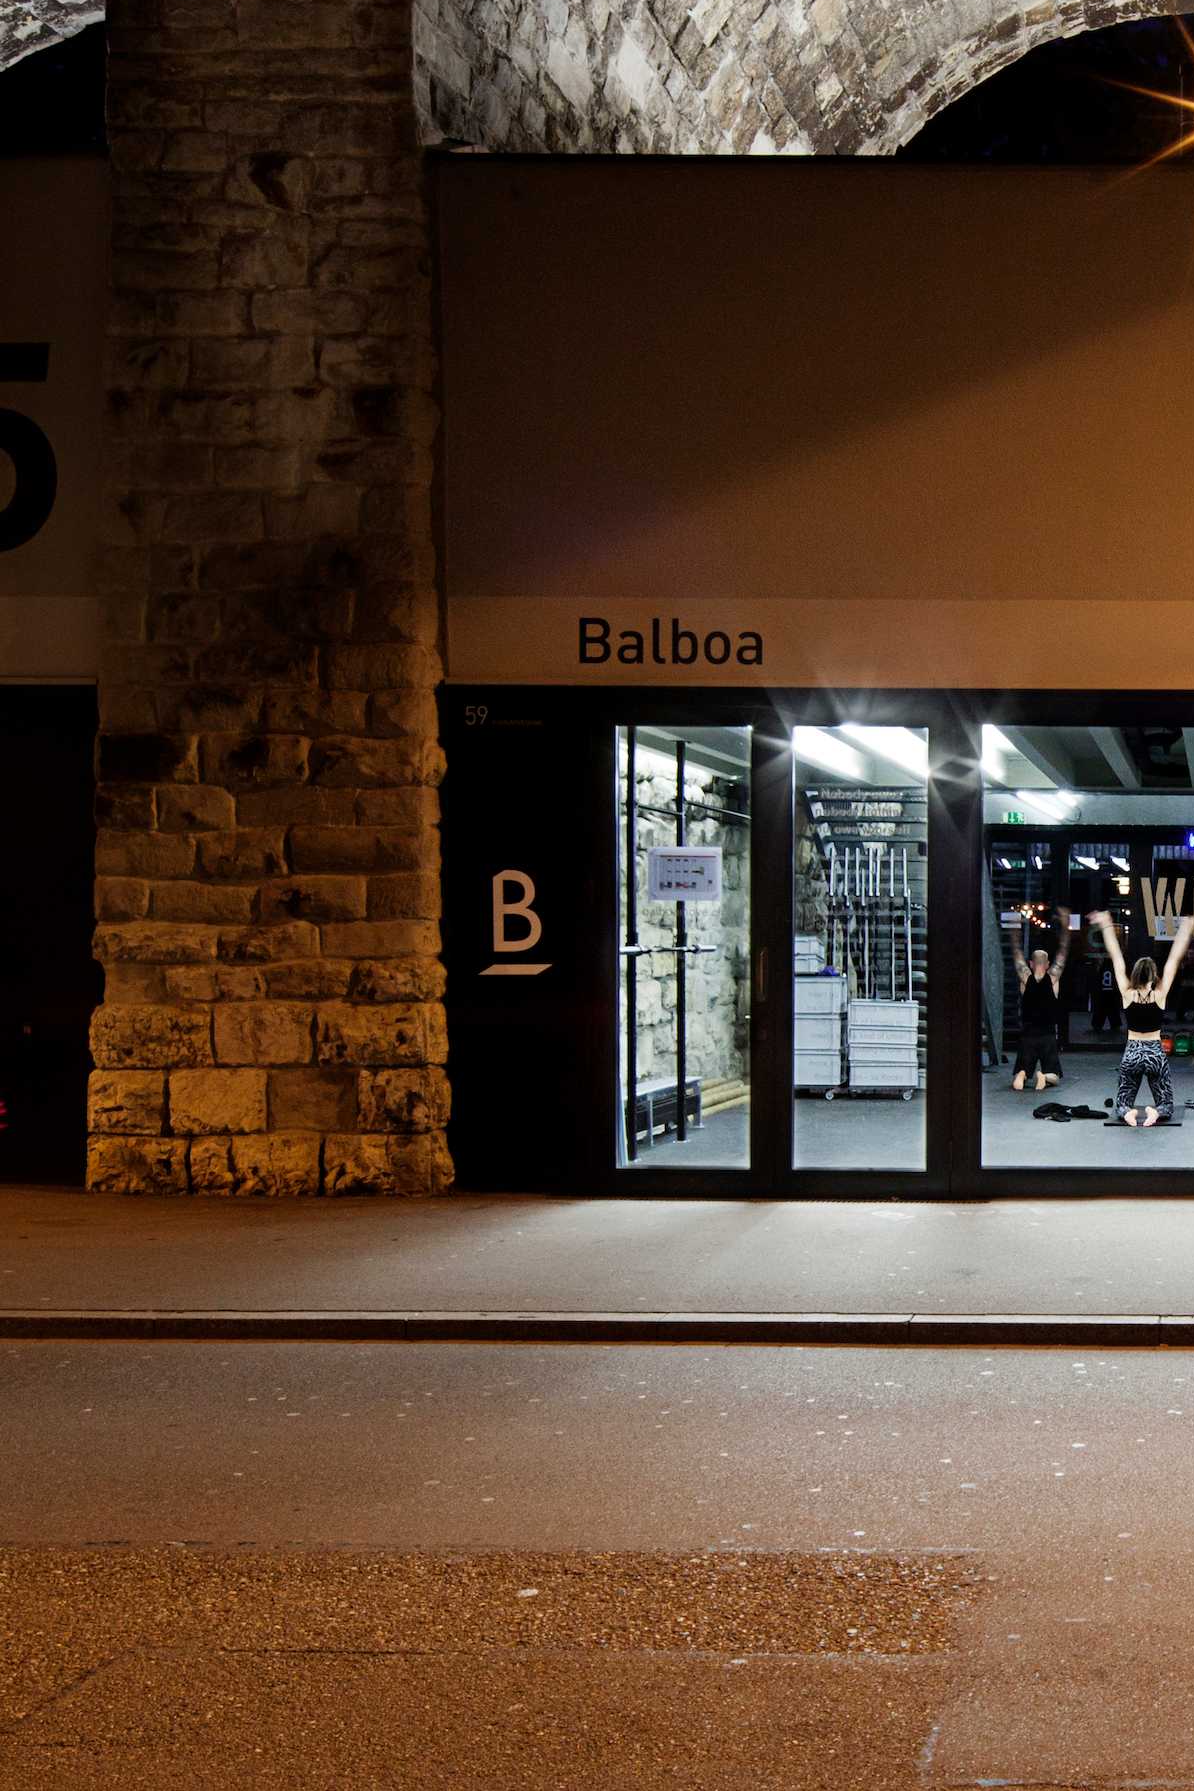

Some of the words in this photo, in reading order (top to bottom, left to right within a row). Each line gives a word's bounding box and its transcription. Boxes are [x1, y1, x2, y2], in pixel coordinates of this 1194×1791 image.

[579, 617, 764, 665] Balboa
[465, 705, 489, 726] 59
[493, 869, 542, 952] B
